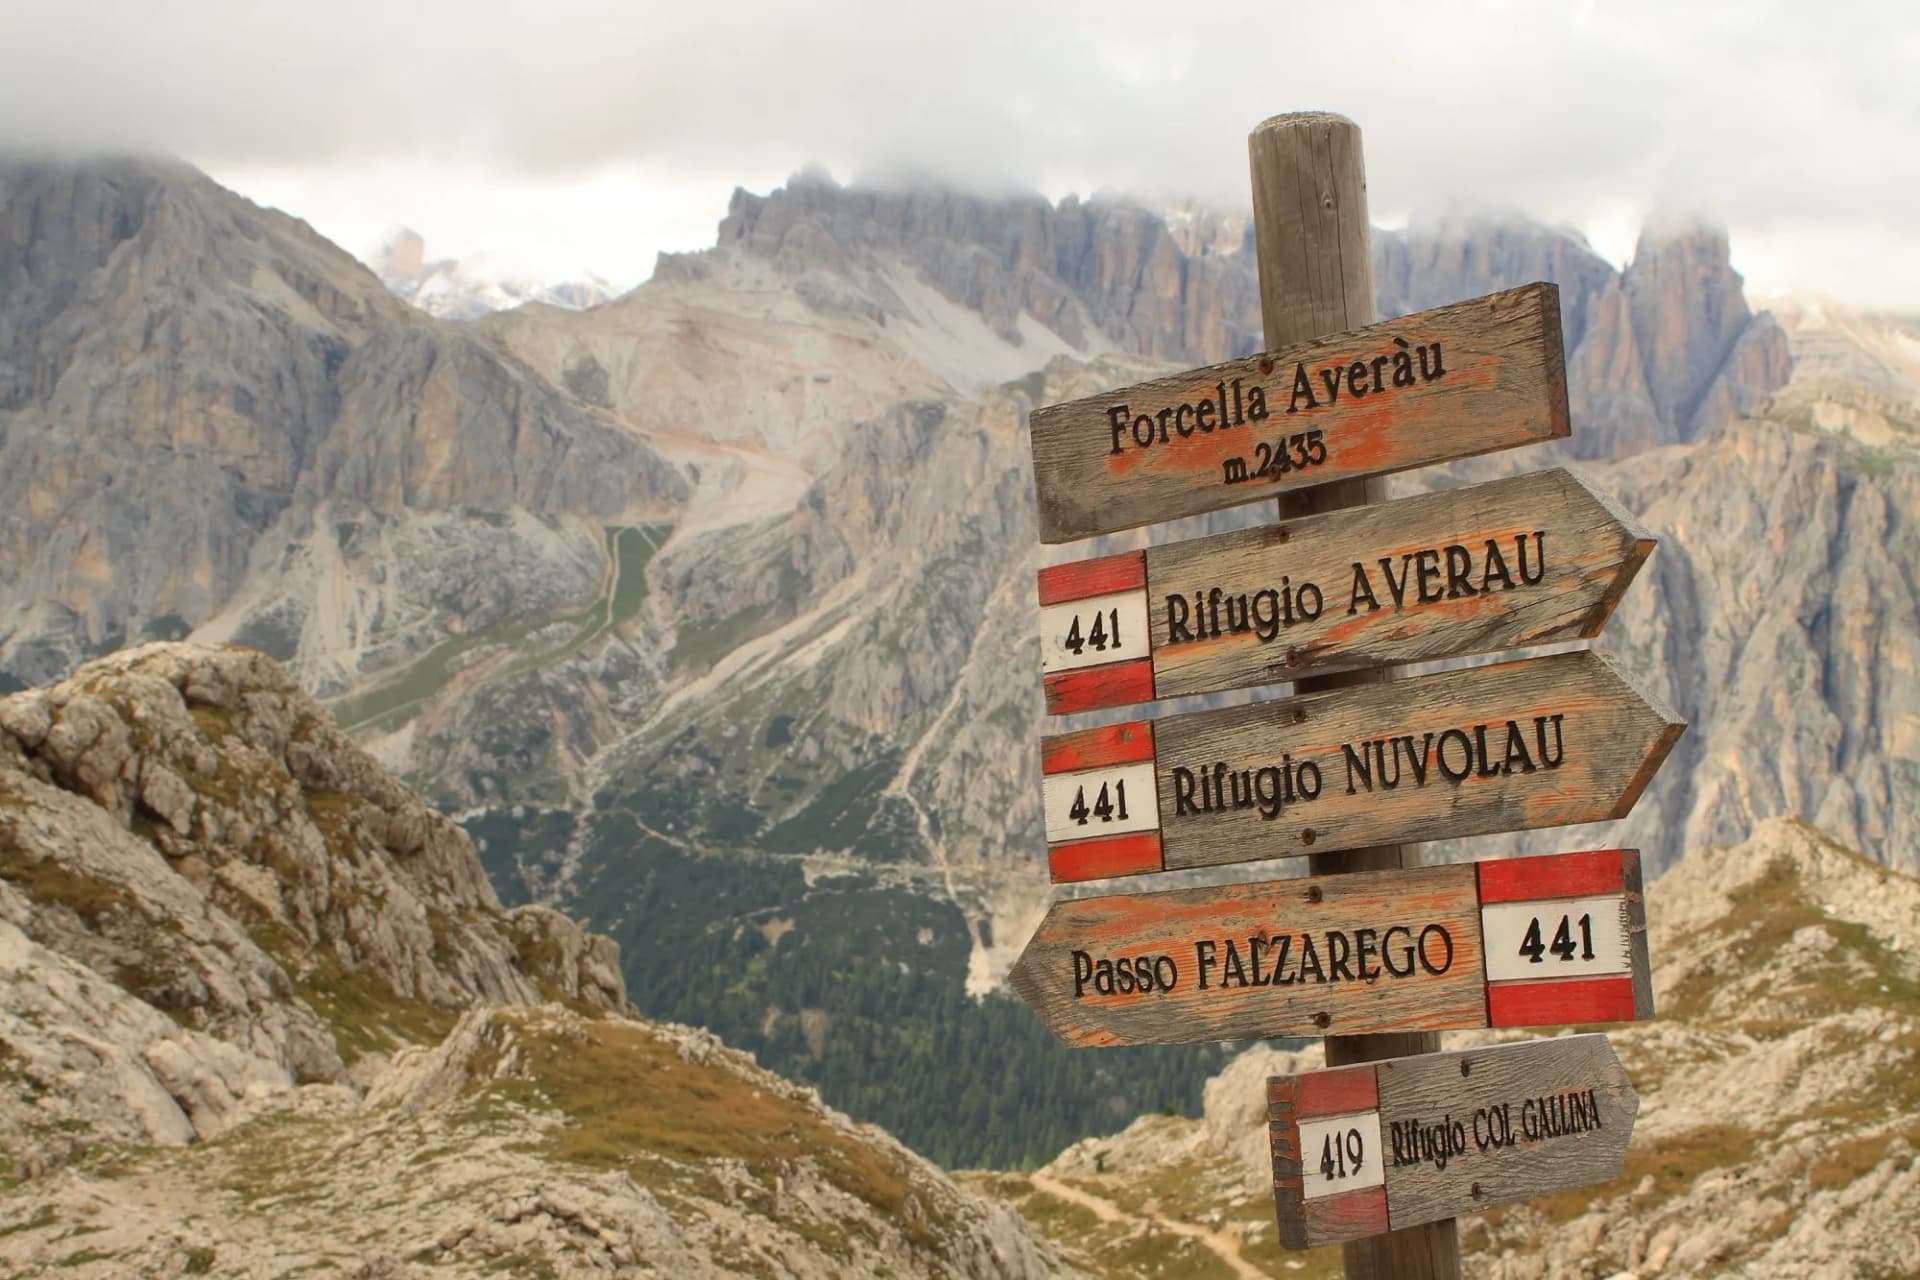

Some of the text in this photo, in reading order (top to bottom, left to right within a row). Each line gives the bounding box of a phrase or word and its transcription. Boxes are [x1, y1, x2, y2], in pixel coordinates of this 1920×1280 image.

[1107, 337, 1447, 454] Forcella Averàu
[1165, 531, 1546, 643] Rifugio AVERAU
[1064, 608, 1122, 655] 441
[1069, 779, 1129, 825] 441
[1172, 714, 1566, 820] Rifugio NUVOLAU
[1071, 923, 1454, 998] Passo FALZAREGO
[1518, 913, 1596, 964] 441
[1319, 1128, 1364, 1181] 419
[1390, 1089, 1602, 1171] Rifugio COL GALLINA
